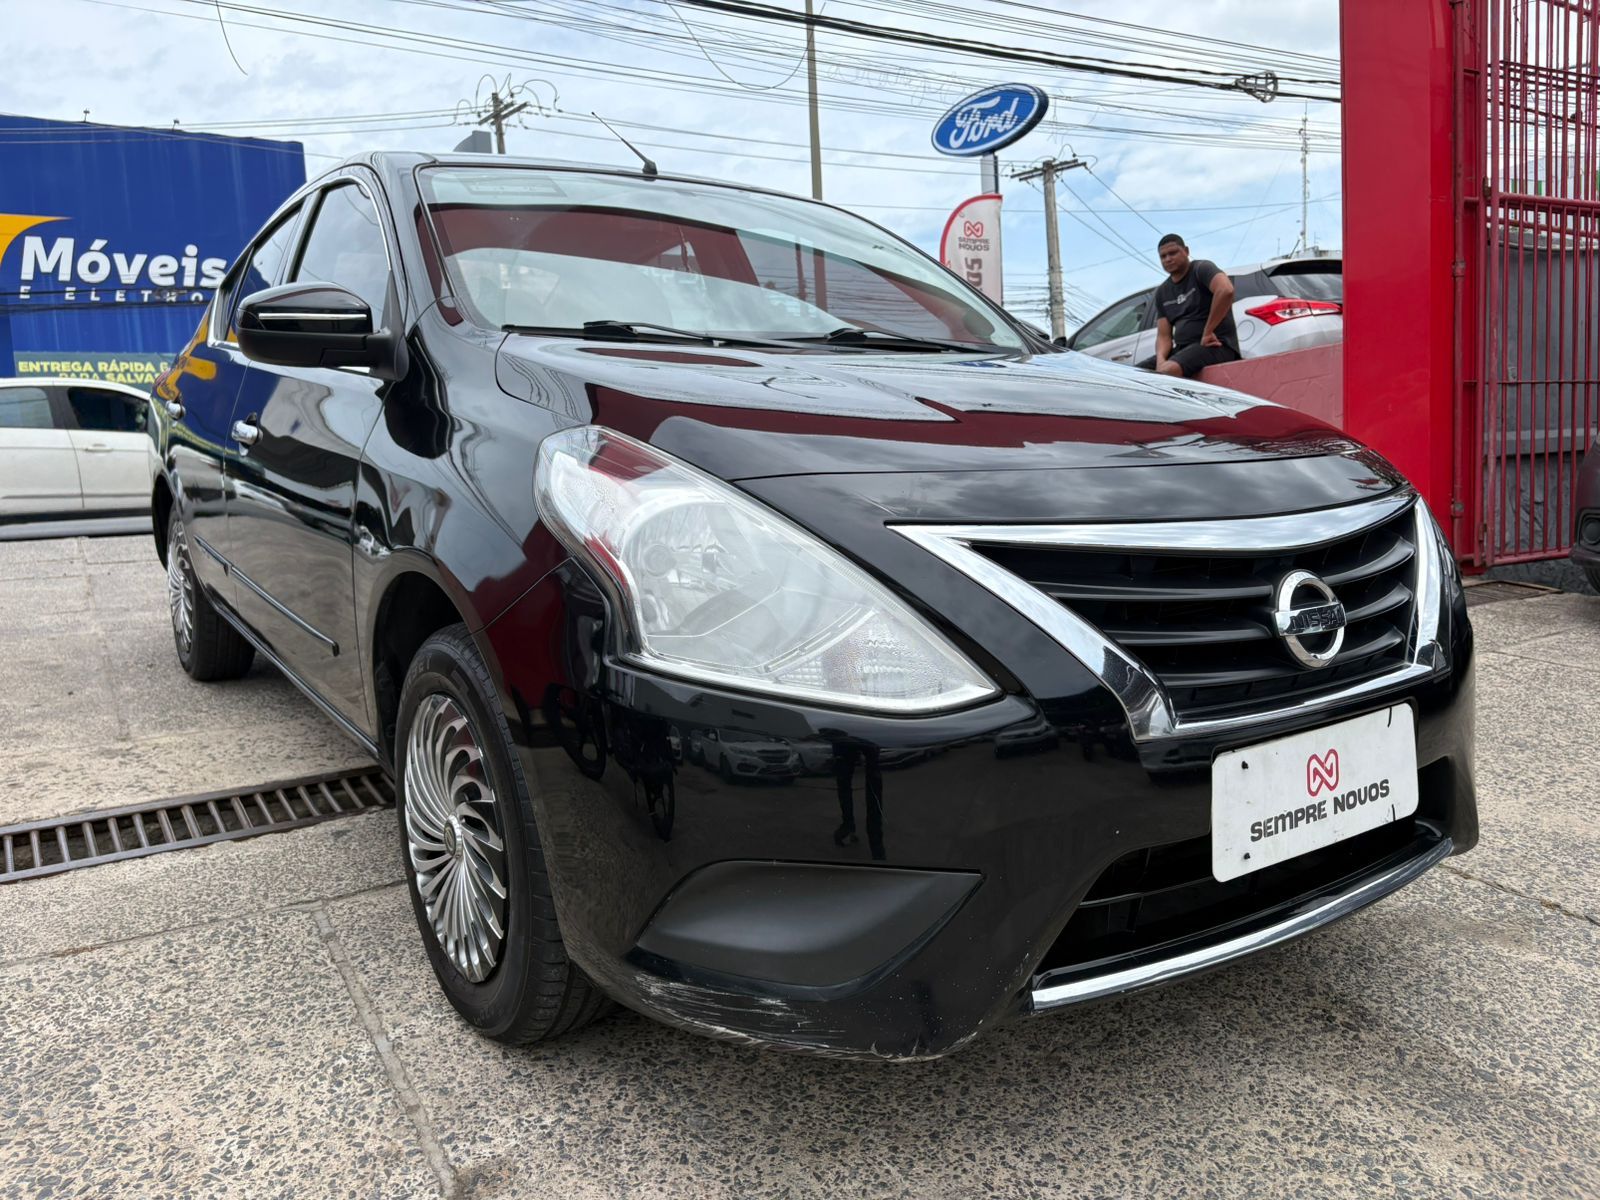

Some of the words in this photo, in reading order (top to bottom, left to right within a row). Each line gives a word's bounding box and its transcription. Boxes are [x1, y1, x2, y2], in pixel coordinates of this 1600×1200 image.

[949, 96, 1019, 148] Ford
[20, 236, 227, 288] Móveis
[18, 360, 95, 373] ENTREGA
[98, 359, 156, 373] RÁPIDA
[105, 373, 160, 384] SALVA
[1289, 605, 1344, 631] NISSAN
[1250, 800, 1327, 842] SEMPRE
